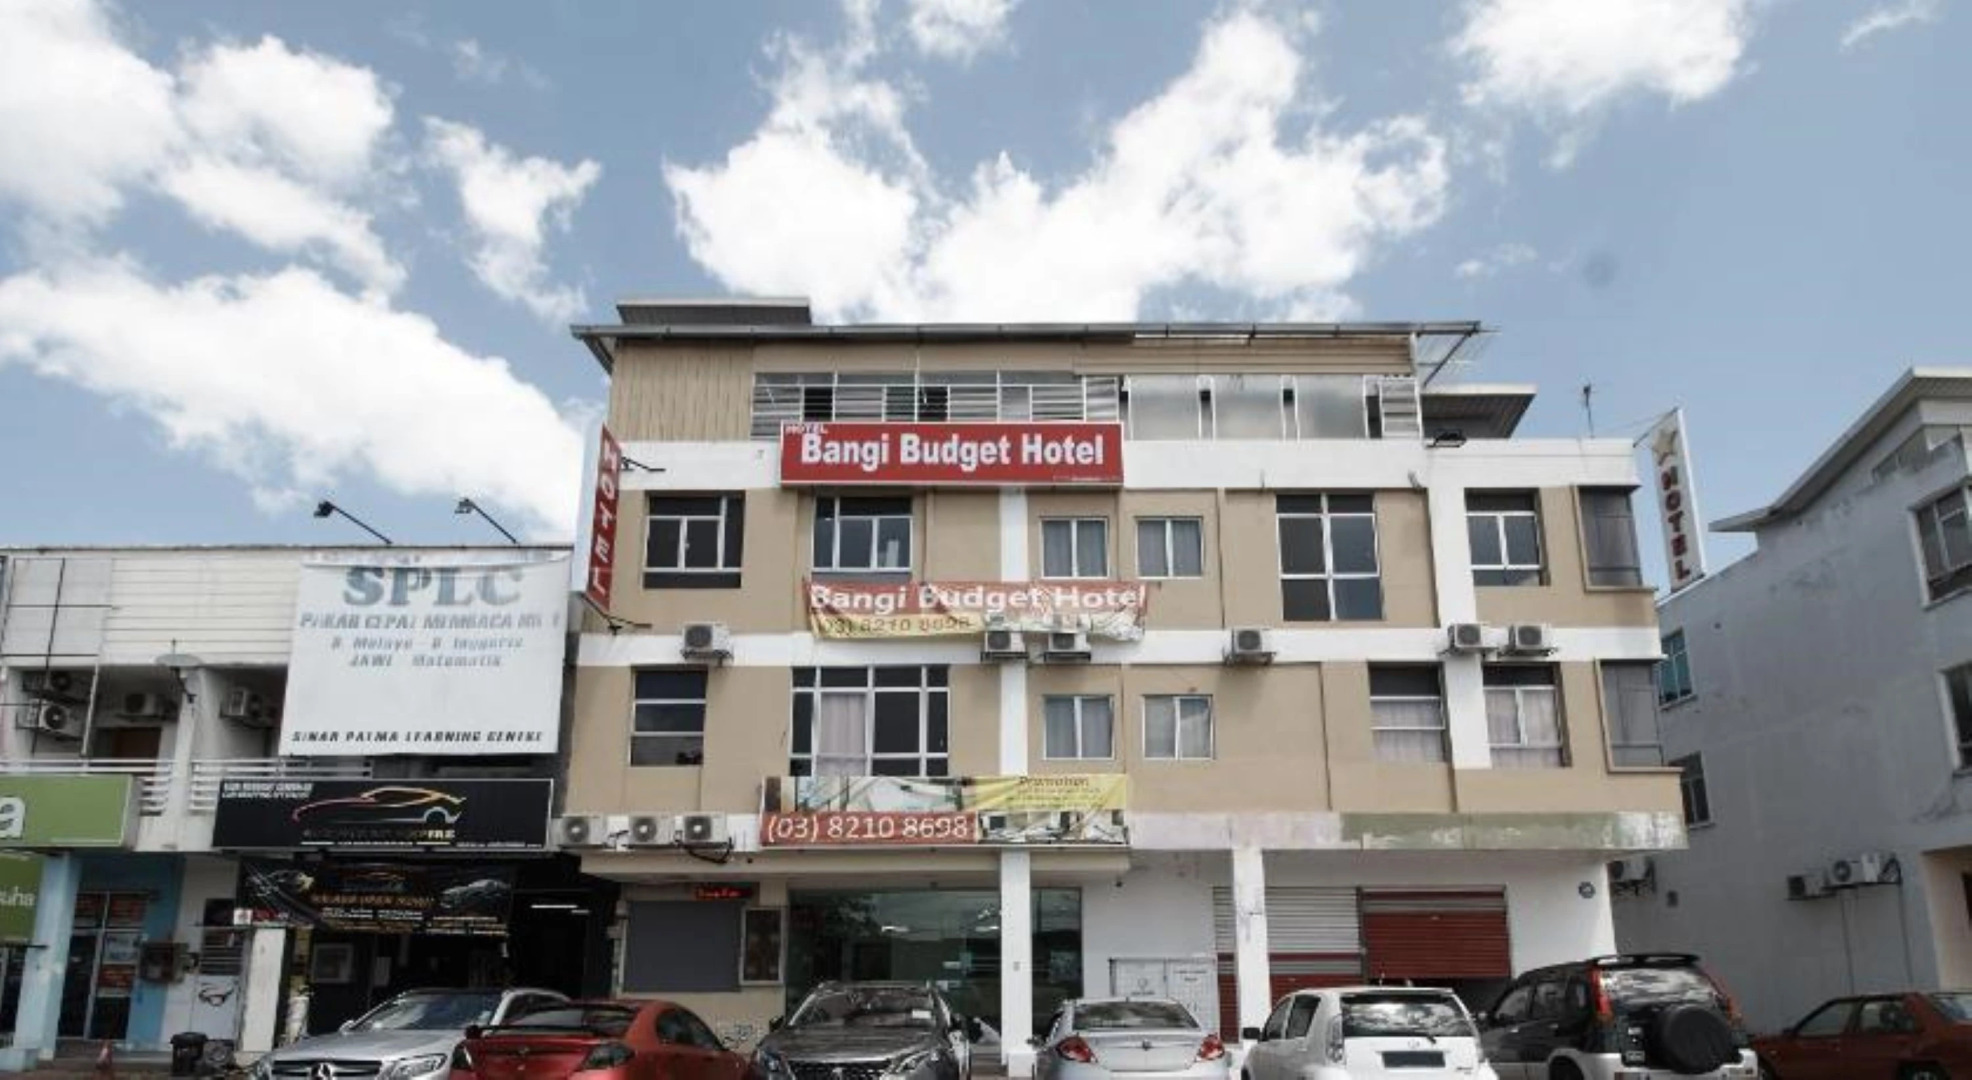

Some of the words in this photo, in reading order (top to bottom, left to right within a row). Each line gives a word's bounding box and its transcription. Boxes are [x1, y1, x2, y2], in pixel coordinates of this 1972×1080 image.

[785, 424, 828, 436] HOTEL
[801, 433, 890, 472] Bangi
[900, 433, 1011, 472] Budget
[1022, 433, 1104, 465] Hotel
[593, 440, 618, 597] HOTEL
[1660, 465, 1691, 581] HOTEL
[342, 567, 523, 607] SPLC
[811, 584, 906, 617] Bangi
[919, 582, 1043, 613] Budget
[1054, 584, 1147, 609] Hotel
[291, 730, 340, 743] SINAR
[767, 814, 819, 844] (03)
[826, 814, 895, 839] 8210
[902, 813, 968, 840] 8698
